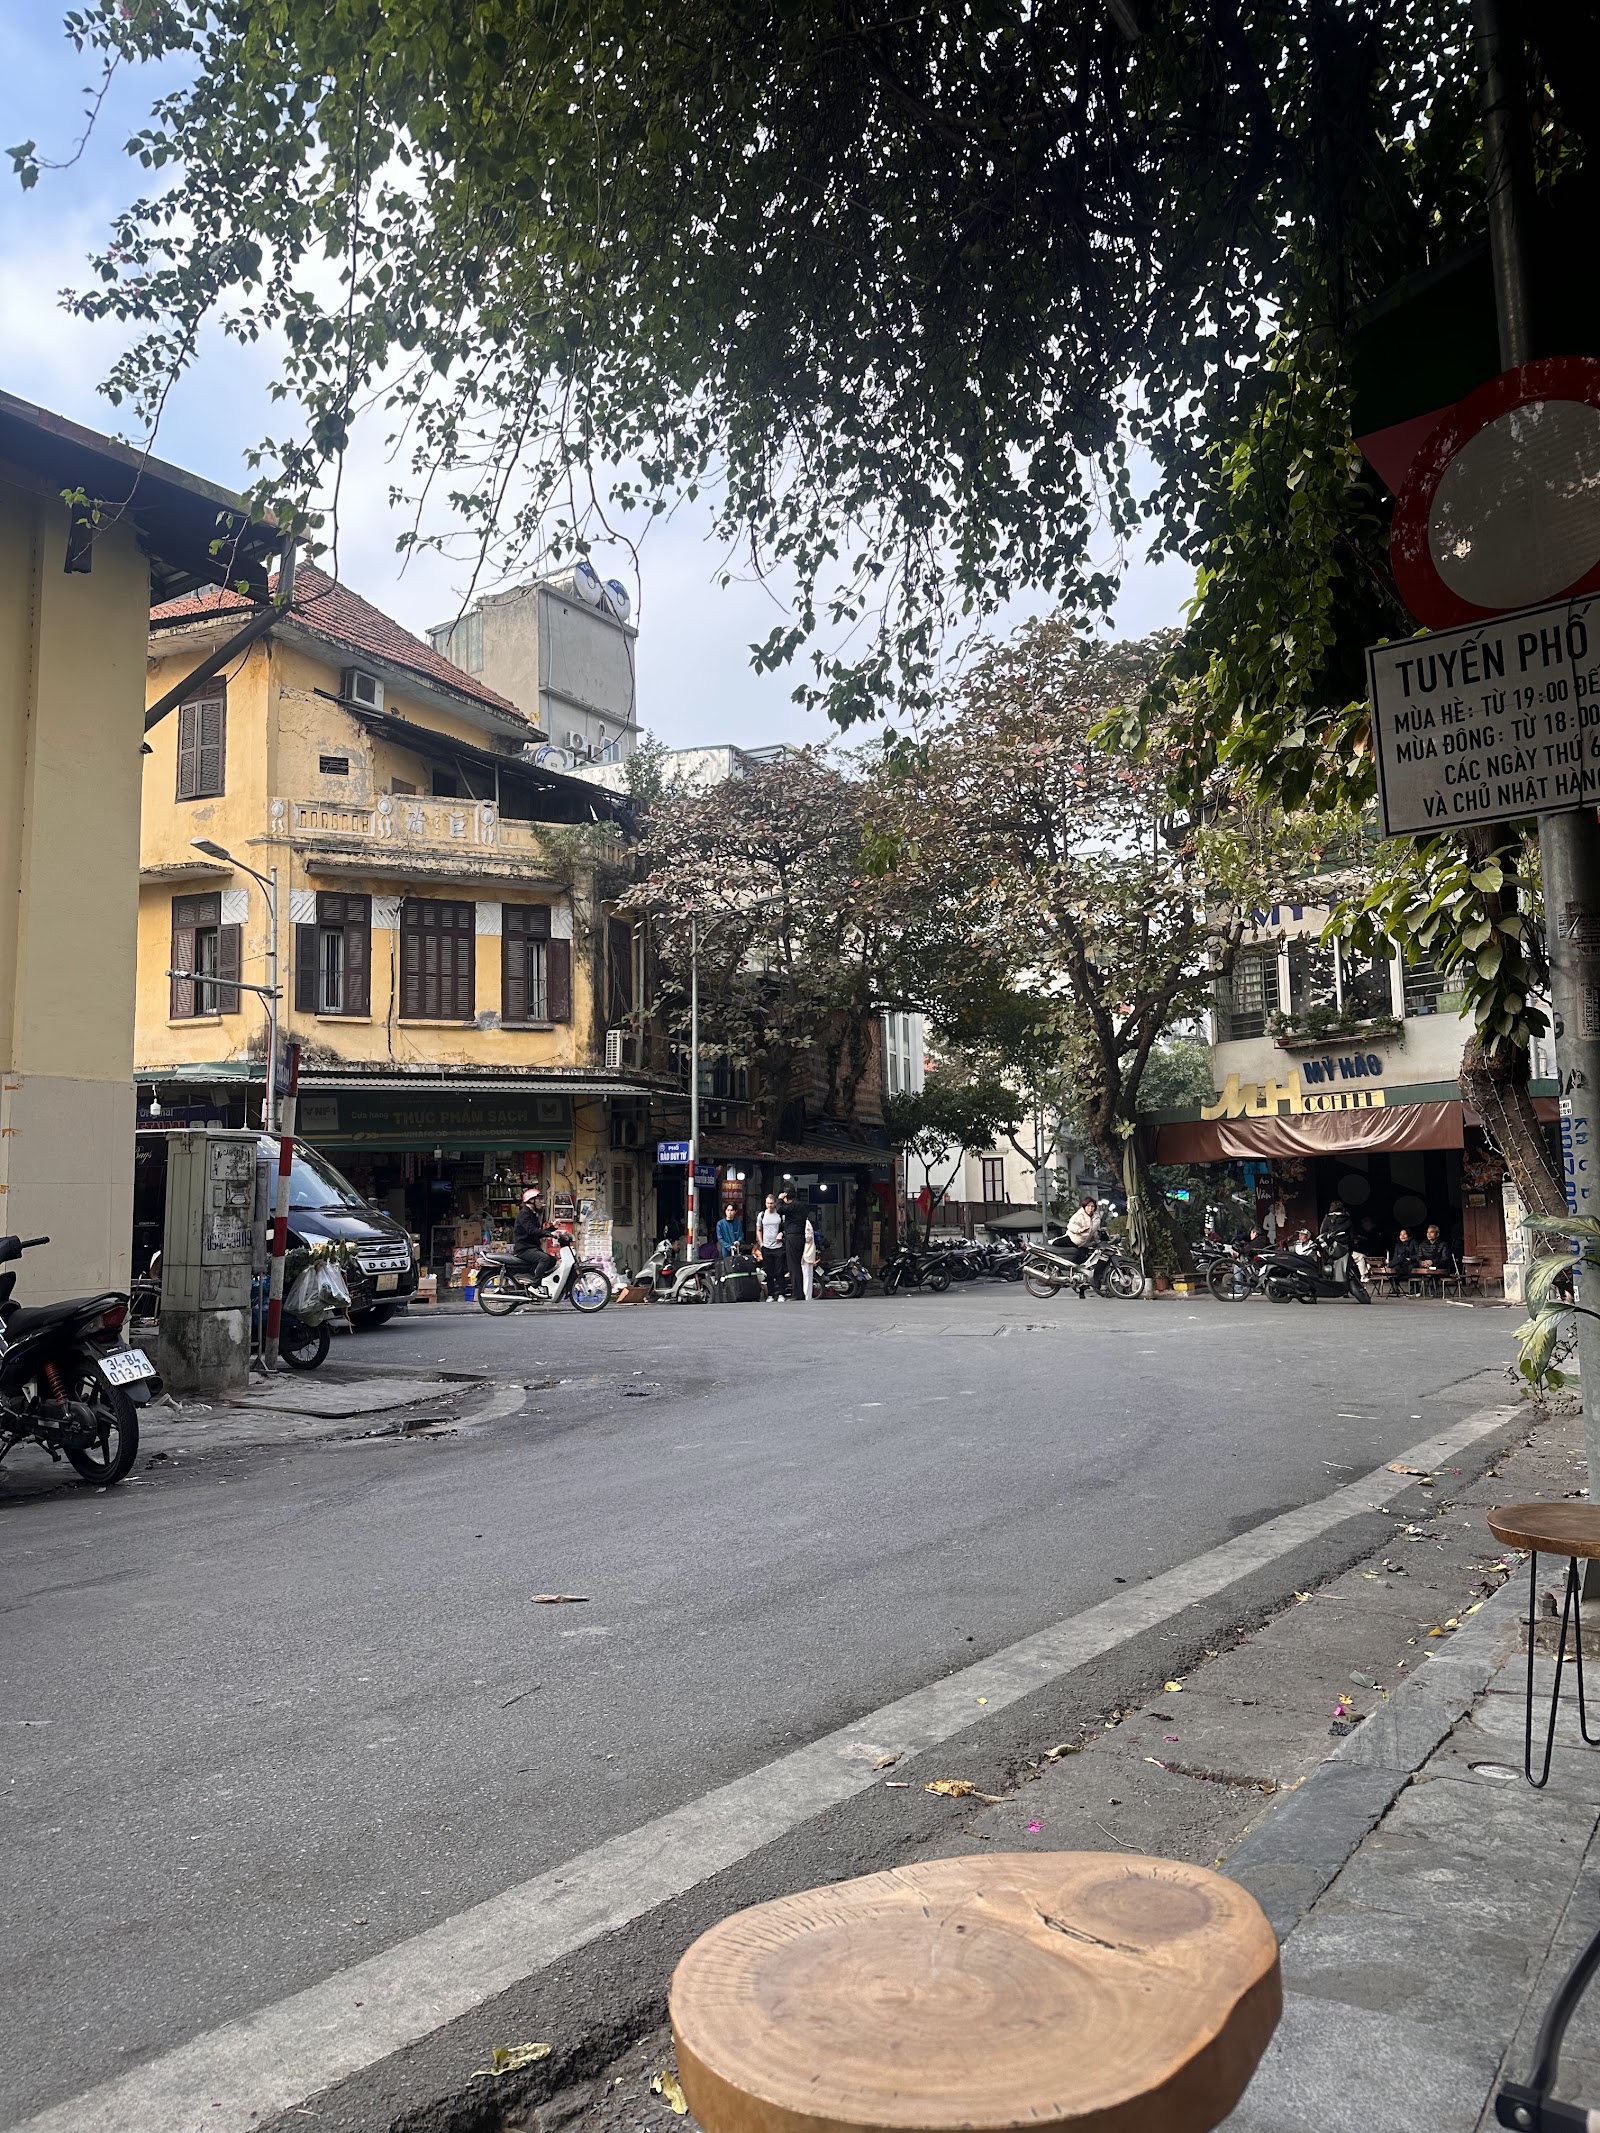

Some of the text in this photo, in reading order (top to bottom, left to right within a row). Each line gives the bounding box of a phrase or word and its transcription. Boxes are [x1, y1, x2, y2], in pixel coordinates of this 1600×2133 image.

[1396, 603, 1592, 697] TUYẾN PHỐ
[1395, 705, 1436, 734] MÙA
[1481, 689, 1506, 717] TỪ
[1513, 679, 1568, 710] 19:00
[1397, 735, 1438, 763] MÙA
[1511, 713, 1536, 741] TỪ
[1544, 704, 1600, 735] 18:00
[1444, 756, 1481, 785] CÁC
[1487, 746, 1537, 777] NGÀY
[1543, 734, 1583, 767] THỨ
[1423, 767, 1600, 817] VÀ CHỦ NHẬT HÀN
[1302, 1051, 1383, 1084] MỸ HẢO
[1304, 1091, 1380, 1112] COFFEE
[487, 1110, 528, 1126] SẠCH
[660, 1150, 688, 1161] ĐÀO DUY TỪ
[668, 1143, 680, 1151] PHỐ
[369, 1260, 407, 1269] DCAR
[106, 1353, 141, 1370] 34-B4
[110, 1363, 152, 1383] 013.79
